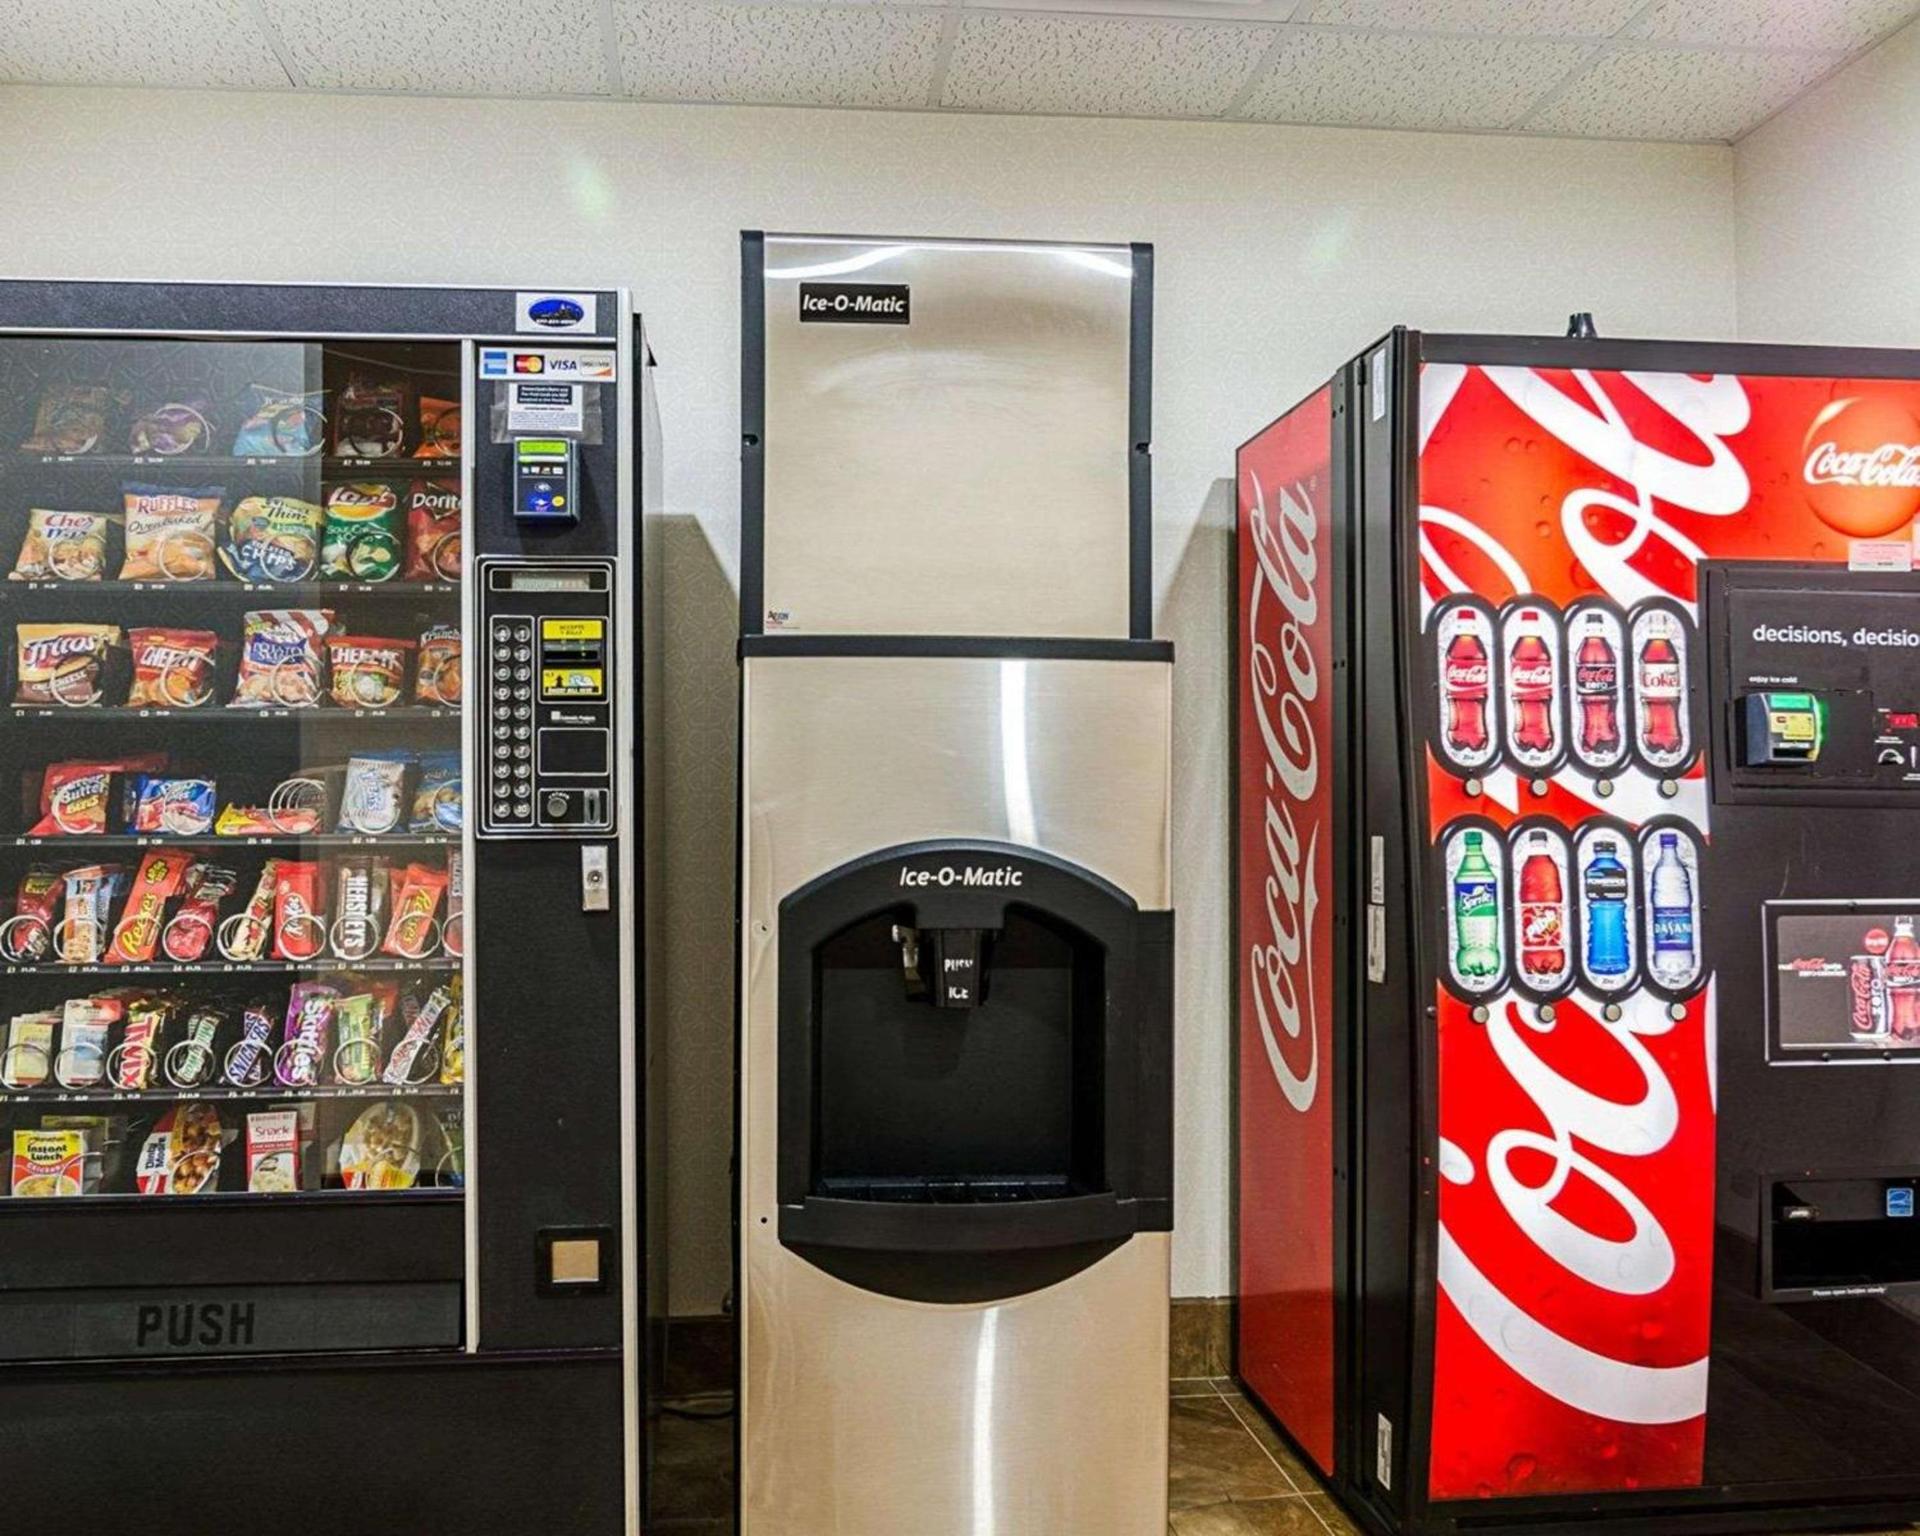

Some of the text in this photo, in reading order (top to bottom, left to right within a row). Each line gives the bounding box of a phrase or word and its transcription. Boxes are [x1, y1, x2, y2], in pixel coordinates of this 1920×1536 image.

[802, 294, 905, 313] Ice-O-Matic
[550, 360, 577, 370] VISA
[138, 497, 198, 514] RUFFLES
[1753, 625, 1847, 647] decisions,
[1448, 664, 1488, 683] Coca-Cola
[1512, 665, 1552, 684] Coca-Cola
[1577, 666, 1615, 683] Coca-Cola
[1642, 672, 1679, 689] Coke
[1250, 469, 1319, 1112] Coca-Cola
[900, 866, 1023, 887] Ice-O-Matic
[1851, 962, 1873, 1030] Coca-Cola
[27, 1144, 68, 1153] Instant
[137, 1302, 255, 1347] PUSH
